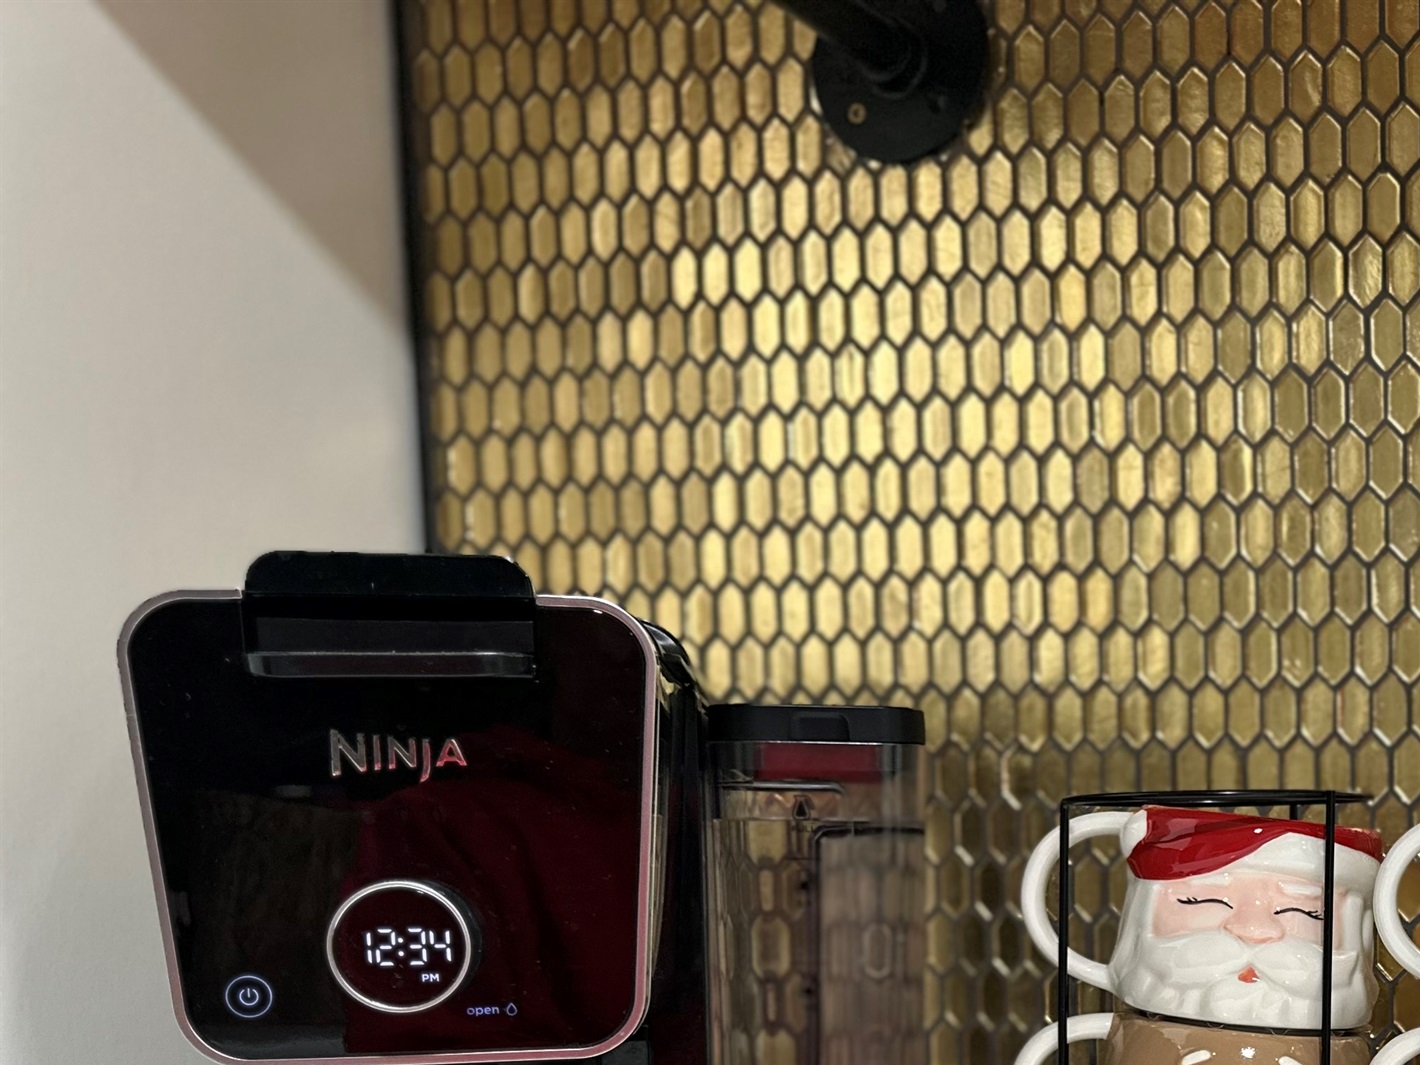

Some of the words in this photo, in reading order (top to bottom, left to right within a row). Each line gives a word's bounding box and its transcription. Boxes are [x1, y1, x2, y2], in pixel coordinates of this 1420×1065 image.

[330, 729, 467, 783] NINJA
[366, 928, 452, 967] 12:34
[421, 973, 440, 983] PM
[466, 1005, 500, 1018] open
